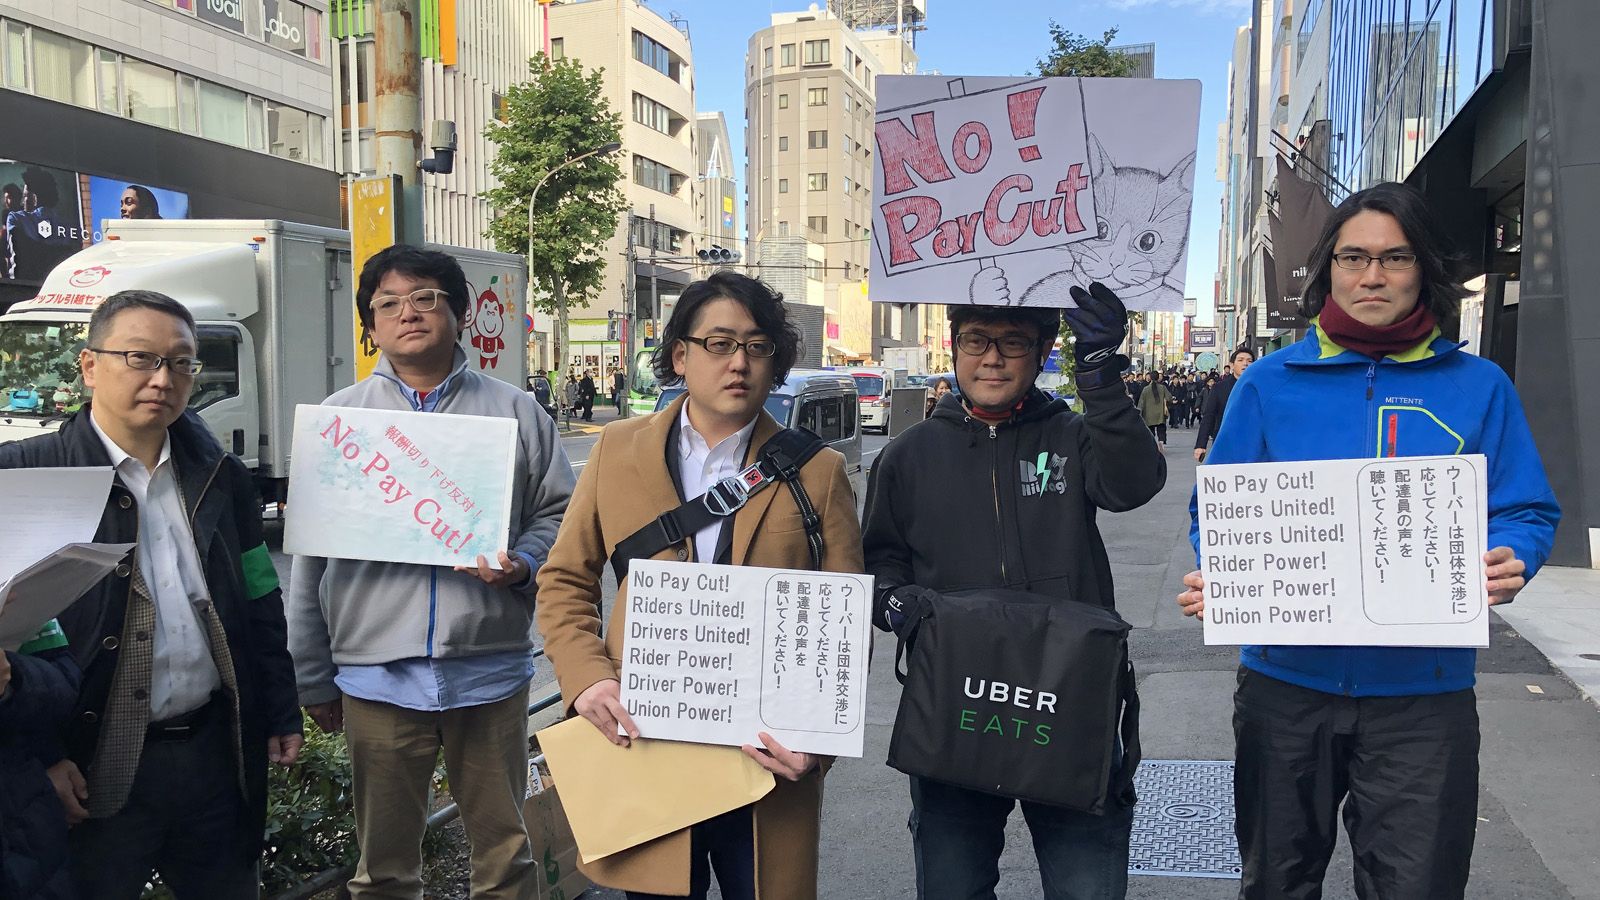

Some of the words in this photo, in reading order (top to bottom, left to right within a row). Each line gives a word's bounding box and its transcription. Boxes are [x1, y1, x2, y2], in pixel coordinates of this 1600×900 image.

[1385, 396, 1424, 405] MITTENTE
[319, 415, 360, 460] No
[361, 451, 413, 504] Pay
[413, 498, 473, 555] Cut!
[1203, 477, 1227, 494] No
[1235, 473, 1268, 494] Pay
[1277, 471, 1315, 490] Cut!
[1206, 501, 1263, 520] Riders
[1271, 497, 1335, 518] United!
[1394, 469, 1413, 558] 配達員の声を
[1207, 528, 1273, 547] Drivers
[1280, 524, 1345, 544] United!
[1370, 470, 1390, 584] 聴いてください！
[1420, 467, 1440, 584] 応じてください！
[1446, 465, 1468, 615] ウーバーは団体交渉に
[1208, 554, 1255, 573] Rider
[1263, 551, 1327, 571] Power!
[633, 570, 654, 588] No
[660, 571, 690, 592] Pay
[697, 573, 730, 593] Cut!
[1210, 581, 1265, 599] Driver
[1273, 578, 1336, 598] Power!
[632, 596, 683, 616] Riders
[690, 599, 745, 619] United!
[1211, 607, 1262, 625] Union
[1269, 604, 1332, 624] Power!
[631, 622, 688, 642] Drivers
[695, 625, 750, 646] United!
[773, 580, 790, 689] 聴いてください！
[794, 581, 811, 667] 配達員の声を
[815, 582, 832, 693] 応じてください！
[630, 648, 671, 667] Rider
[678, 650, 733, 671] Power!
[834, 584, 853, 725] ウーバーは団体交渉に
[628, 673, 676, 693] Driver
[683, 676, 738, 697] Power!
[963, 676, 1059, 714] UBER
[627, 699, 671, 718] Union
[677, 702, 732, 723] Power!
[959, 709, 1053, 746] EATS
